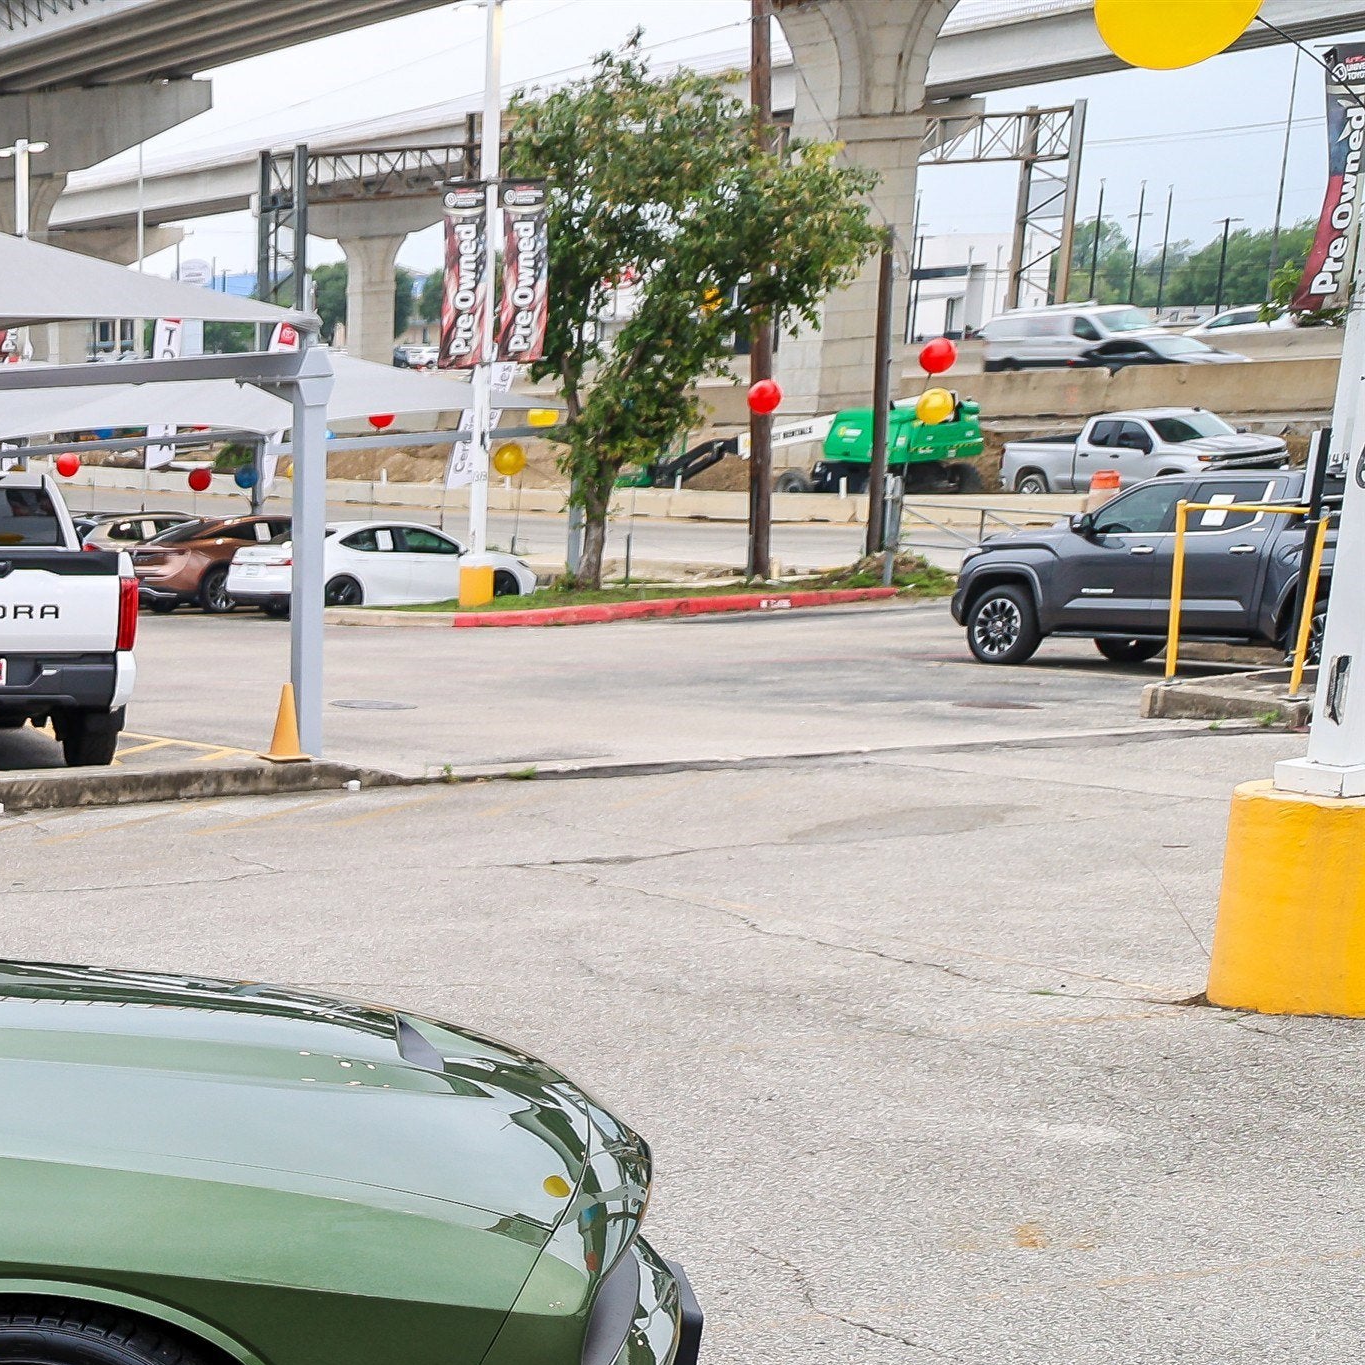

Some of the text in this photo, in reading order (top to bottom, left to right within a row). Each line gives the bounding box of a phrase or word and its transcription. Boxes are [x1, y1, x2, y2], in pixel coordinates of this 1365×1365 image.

[1310, 235, 1348, 296] Pre
[1331, 106, 1365, 229] Owned
[453, 223, 477, 310] Owned
[512, 221, 535, 308] Owned
